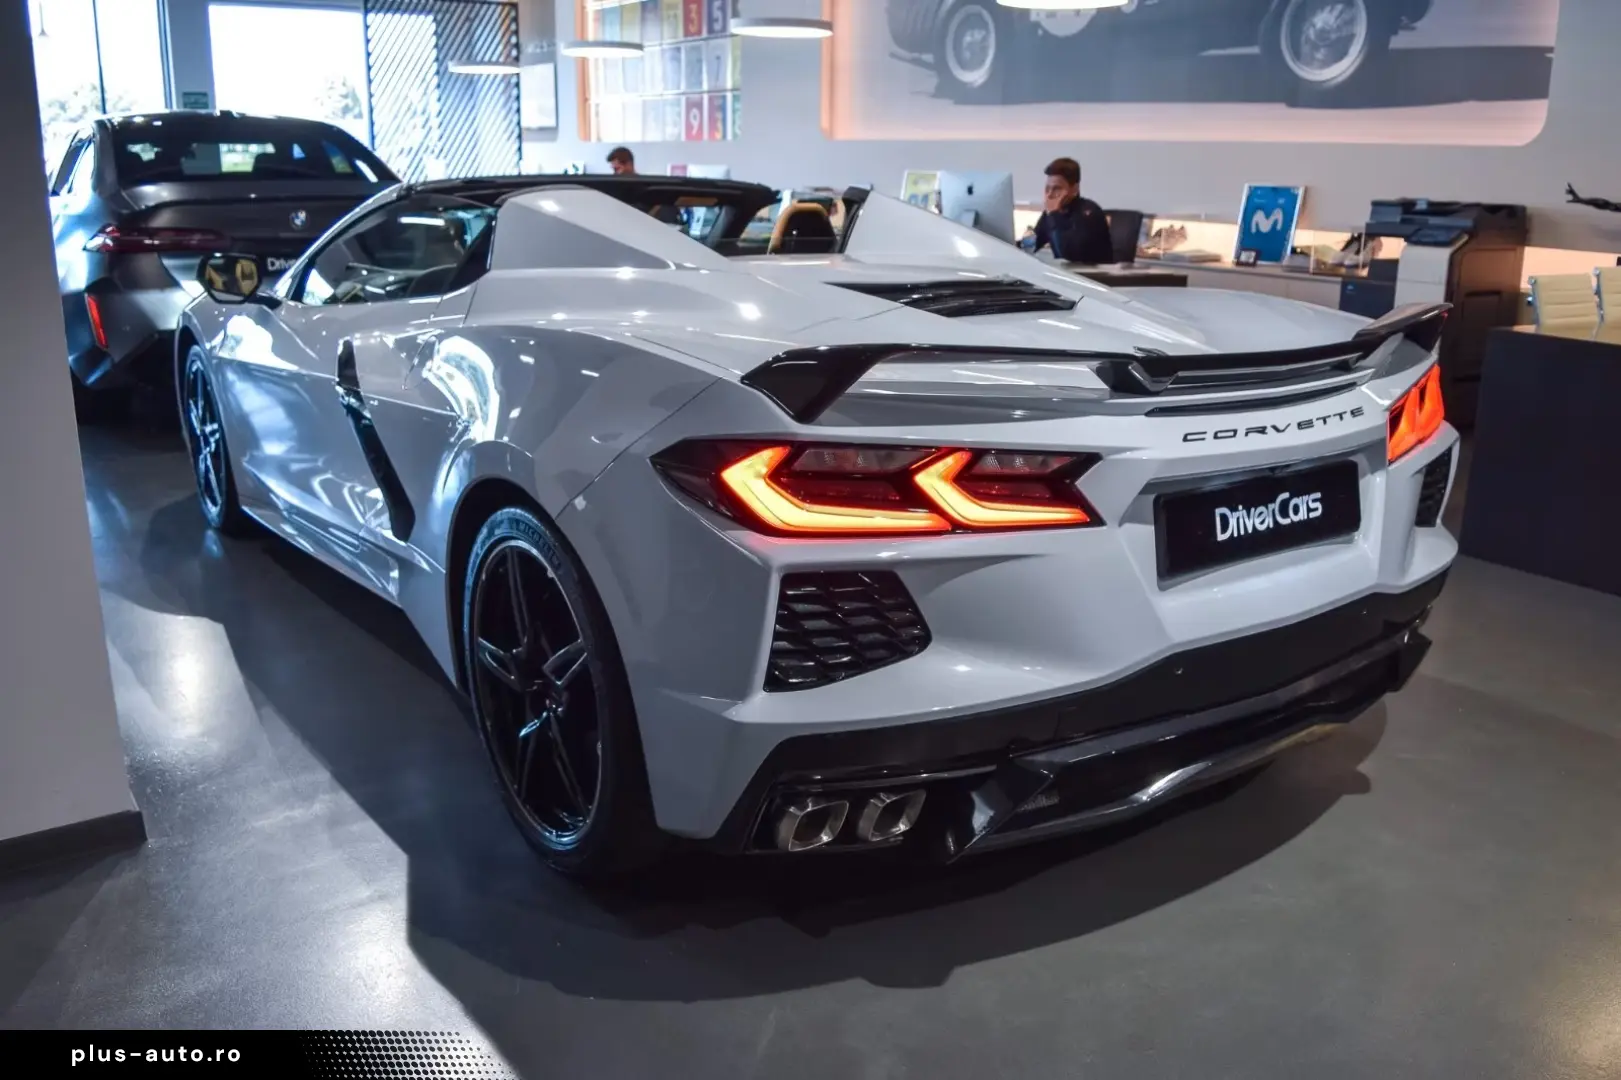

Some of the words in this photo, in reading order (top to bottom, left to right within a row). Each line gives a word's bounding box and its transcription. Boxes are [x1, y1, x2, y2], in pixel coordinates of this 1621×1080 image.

[711, 1, 723, 32] 5
[689, 107, 701, 136] 9
[1181, 406, 1365, 443] CORVETTE
[1214, 492, 1323, 542] DriverCars
